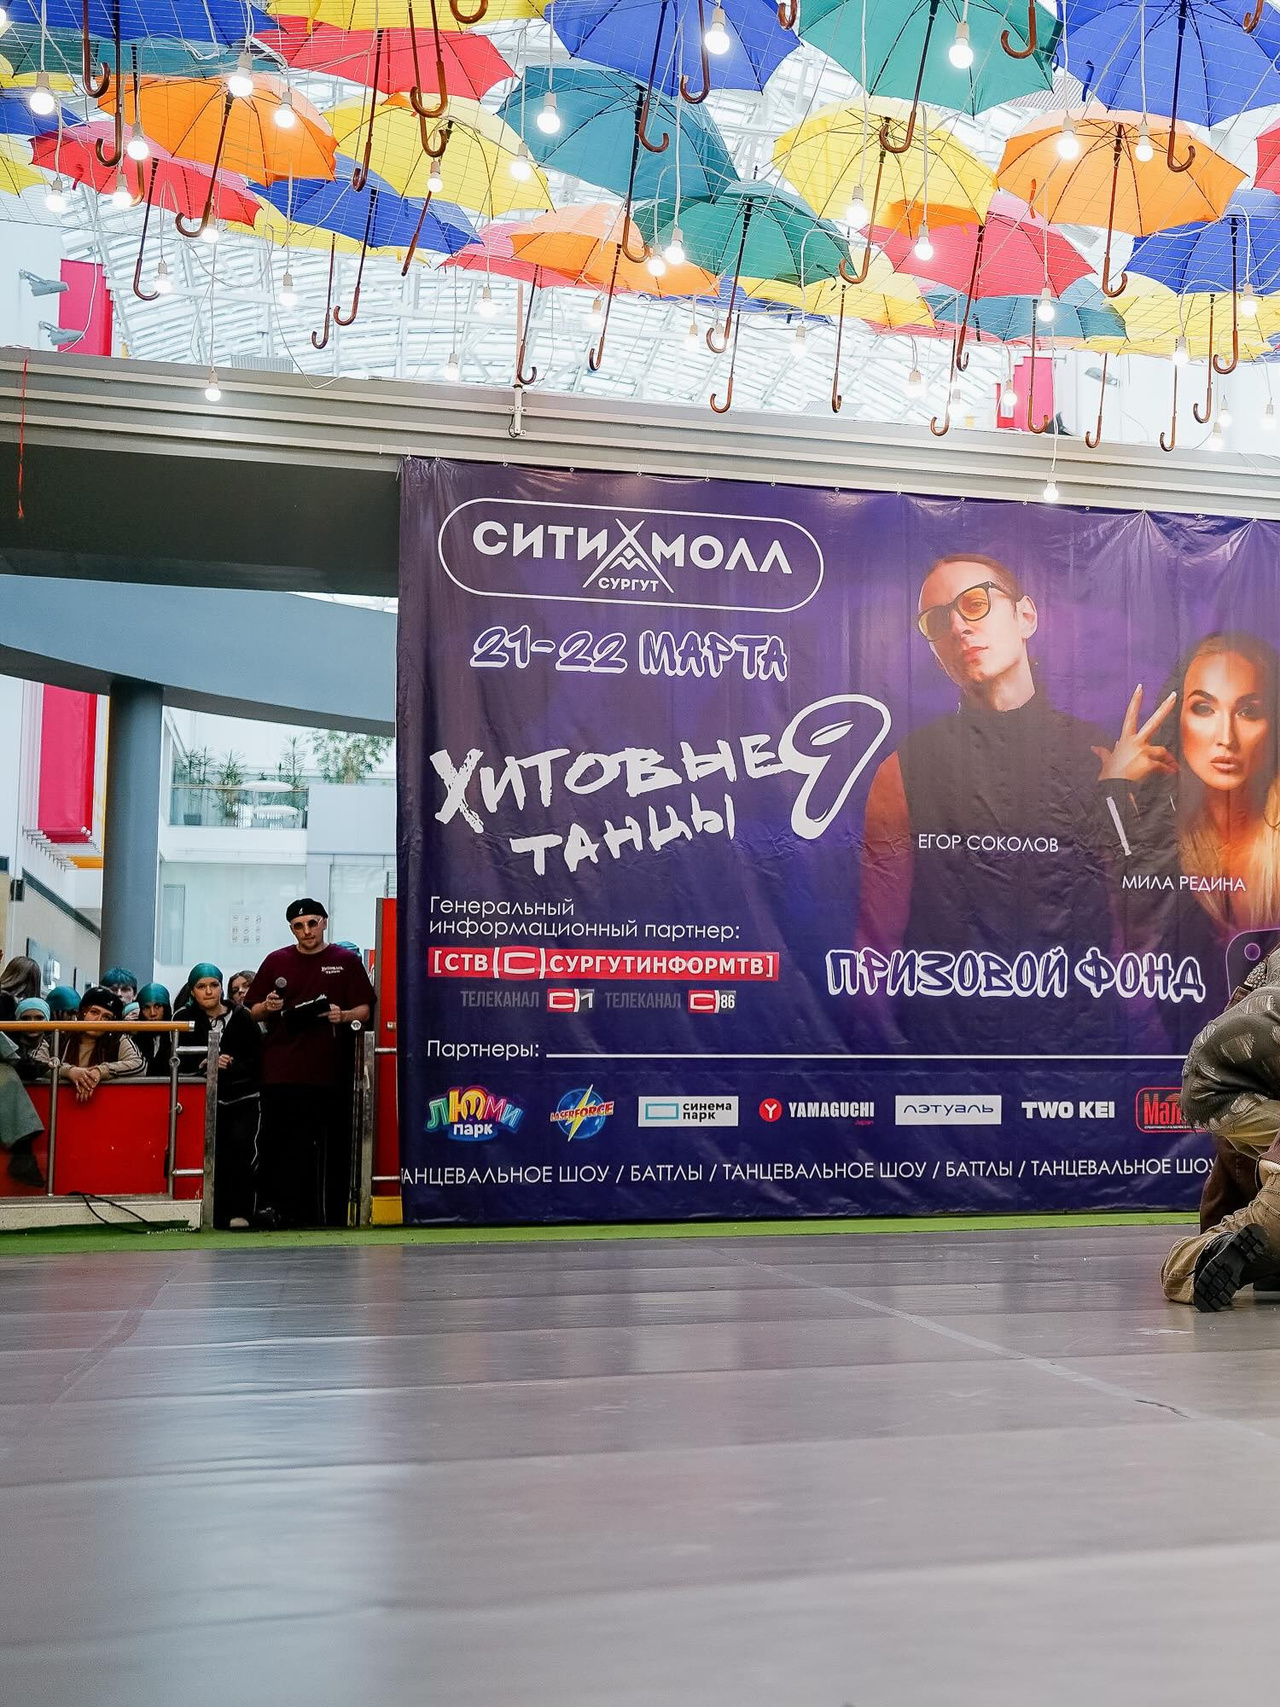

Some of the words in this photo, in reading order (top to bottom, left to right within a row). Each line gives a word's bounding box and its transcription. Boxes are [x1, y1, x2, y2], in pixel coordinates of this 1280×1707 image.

[472, 519, 608, 560] СИТИ
[652, 534, 794, 575] МОЛЛ
[598, 576, 659, 593] СУРГУТ
[470, 624, 629, 675] 21-22
[639, 630, 789, 682] МАРТА
[917, 833, 961, 850] ЕГОР
[966, 834, 1059, 853] СОКОЛОВ
[1121, 875, 1174, 891] МИЛА
[1179, 876, 1246, 893] РЕДИНА
[430, 896, 574, 917] Генеральный
[429, 917, 637, 941] информационный
[644, 924, 740, 942] партнер:
[825, 946, 1068, 999] ПРИЗОВОЙ
[1074, 947, 1206, 1003] ФОНД
[460, 991, 540, 1008] ТЕЛЕКАНАЛ
[605, 992, 681, 1009] ТЕЛЕКАНАЛ
[427, 1040, 540, 1060] Партнеры:
[683, 1111, 716, 1122] парк
[788, 1102, 875, 1118] YAMAGUCHI
[1022, 1102, 1074, 1119] TWO
[1079, 1102, 1115, 1119] KEI
[453, 1123, 494, 1138] парк
[559, 1165, 609, 1183] ШОУ
[630, 1163, 703, 1181] БАТТЛЫ
[723, 1161, 875, 1181] ТАНЦЕВАЛЬНОЕ
[880, 1162, 926, 1179] ШОУ
[946, 1160, 1013, 1178] БАТТЛЫ
[1031, 1158, 1171, 1177] ТАНЦЕВАЛЬНОЕ
